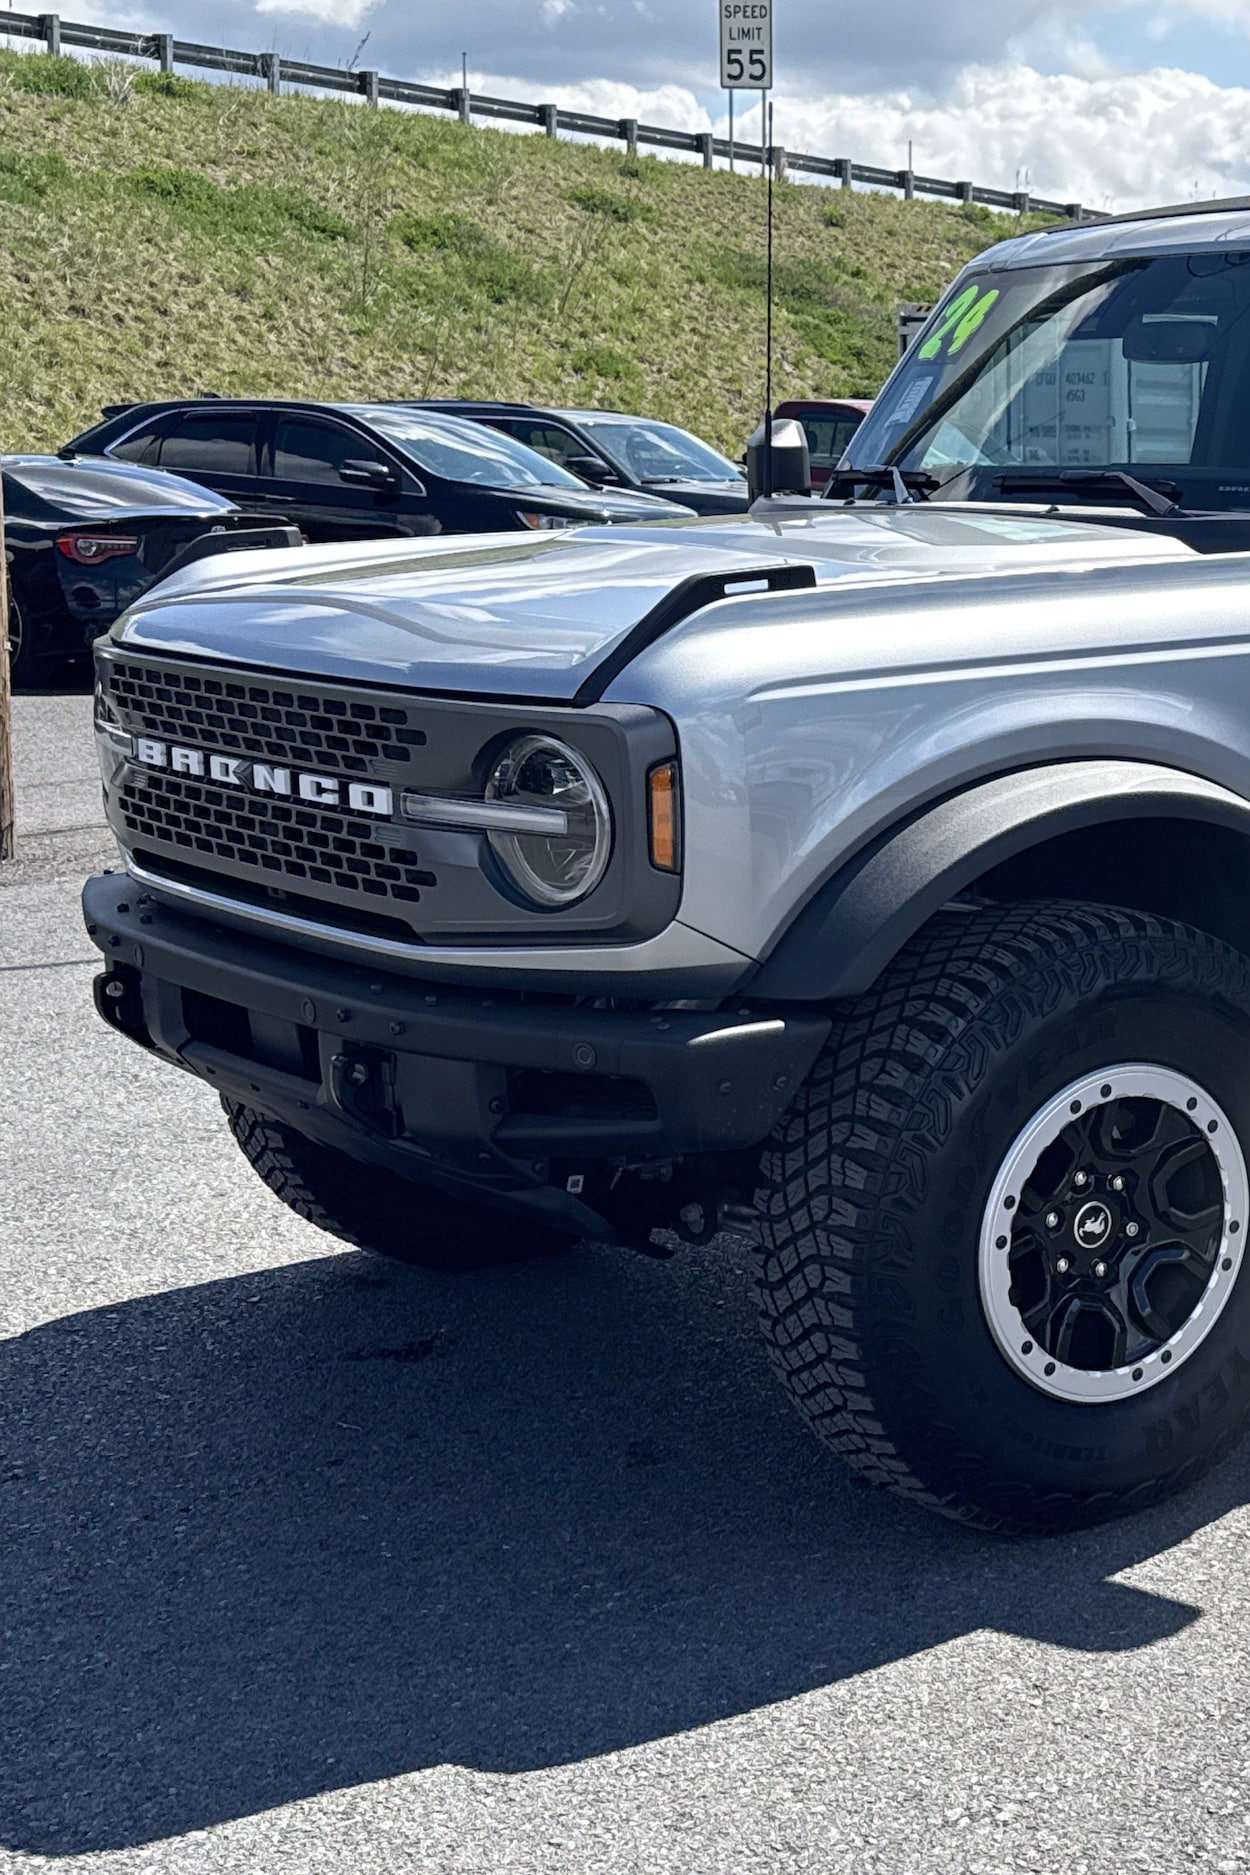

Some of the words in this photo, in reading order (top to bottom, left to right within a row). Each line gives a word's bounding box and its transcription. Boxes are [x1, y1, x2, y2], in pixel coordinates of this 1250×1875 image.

[724, 5, 768, 19] SPEED
[729, 26, 763, 41] LIMIT
[727, 49, 767, 81] 55
[918, 285, 1000, 361] 24
[137, 737, 394, 816] BRONCO
